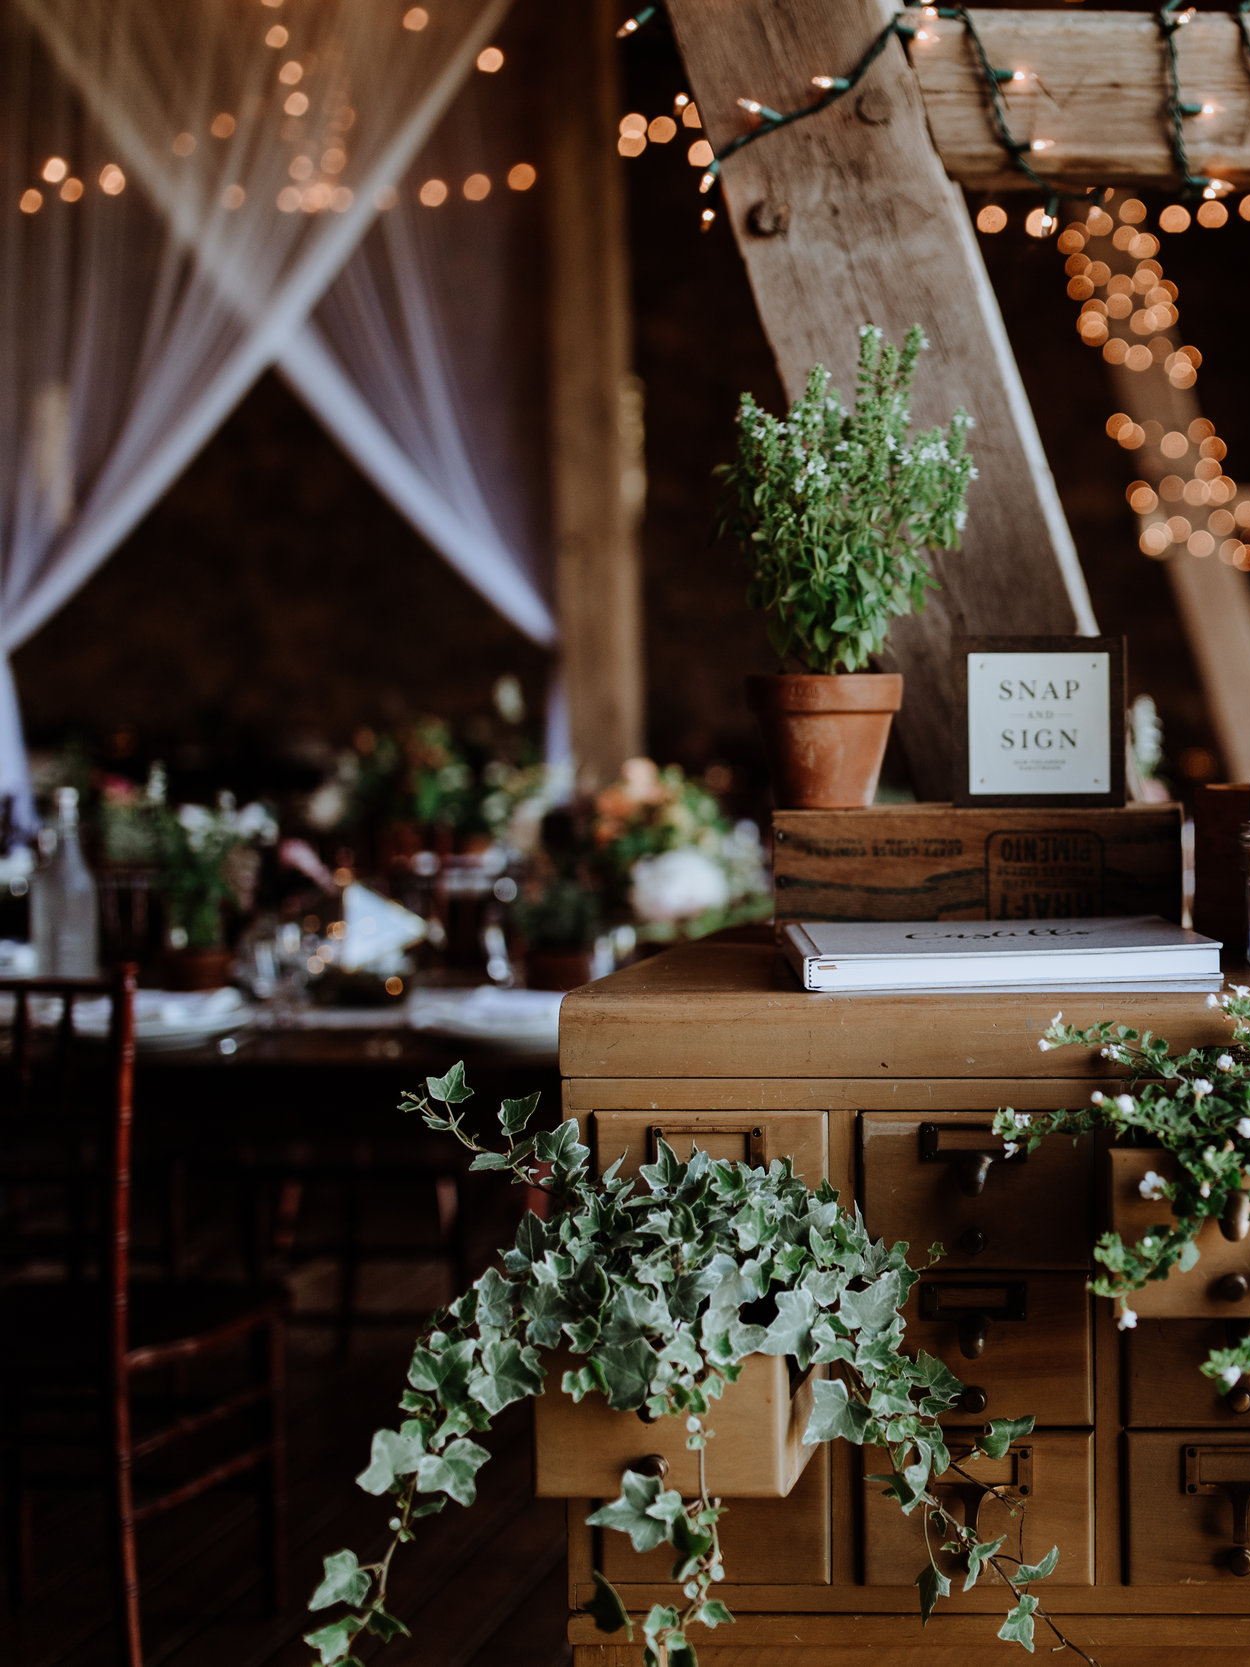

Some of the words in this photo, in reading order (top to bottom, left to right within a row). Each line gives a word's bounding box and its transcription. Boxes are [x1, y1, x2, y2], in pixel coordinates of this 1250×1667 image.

[998, 679, 1080, 701] SNAP
[1026, 710, 1054, 720] AND
[1000, 728, 1078, 750] SIGN
[1000, 837, 1092, 863] PIMENTO
